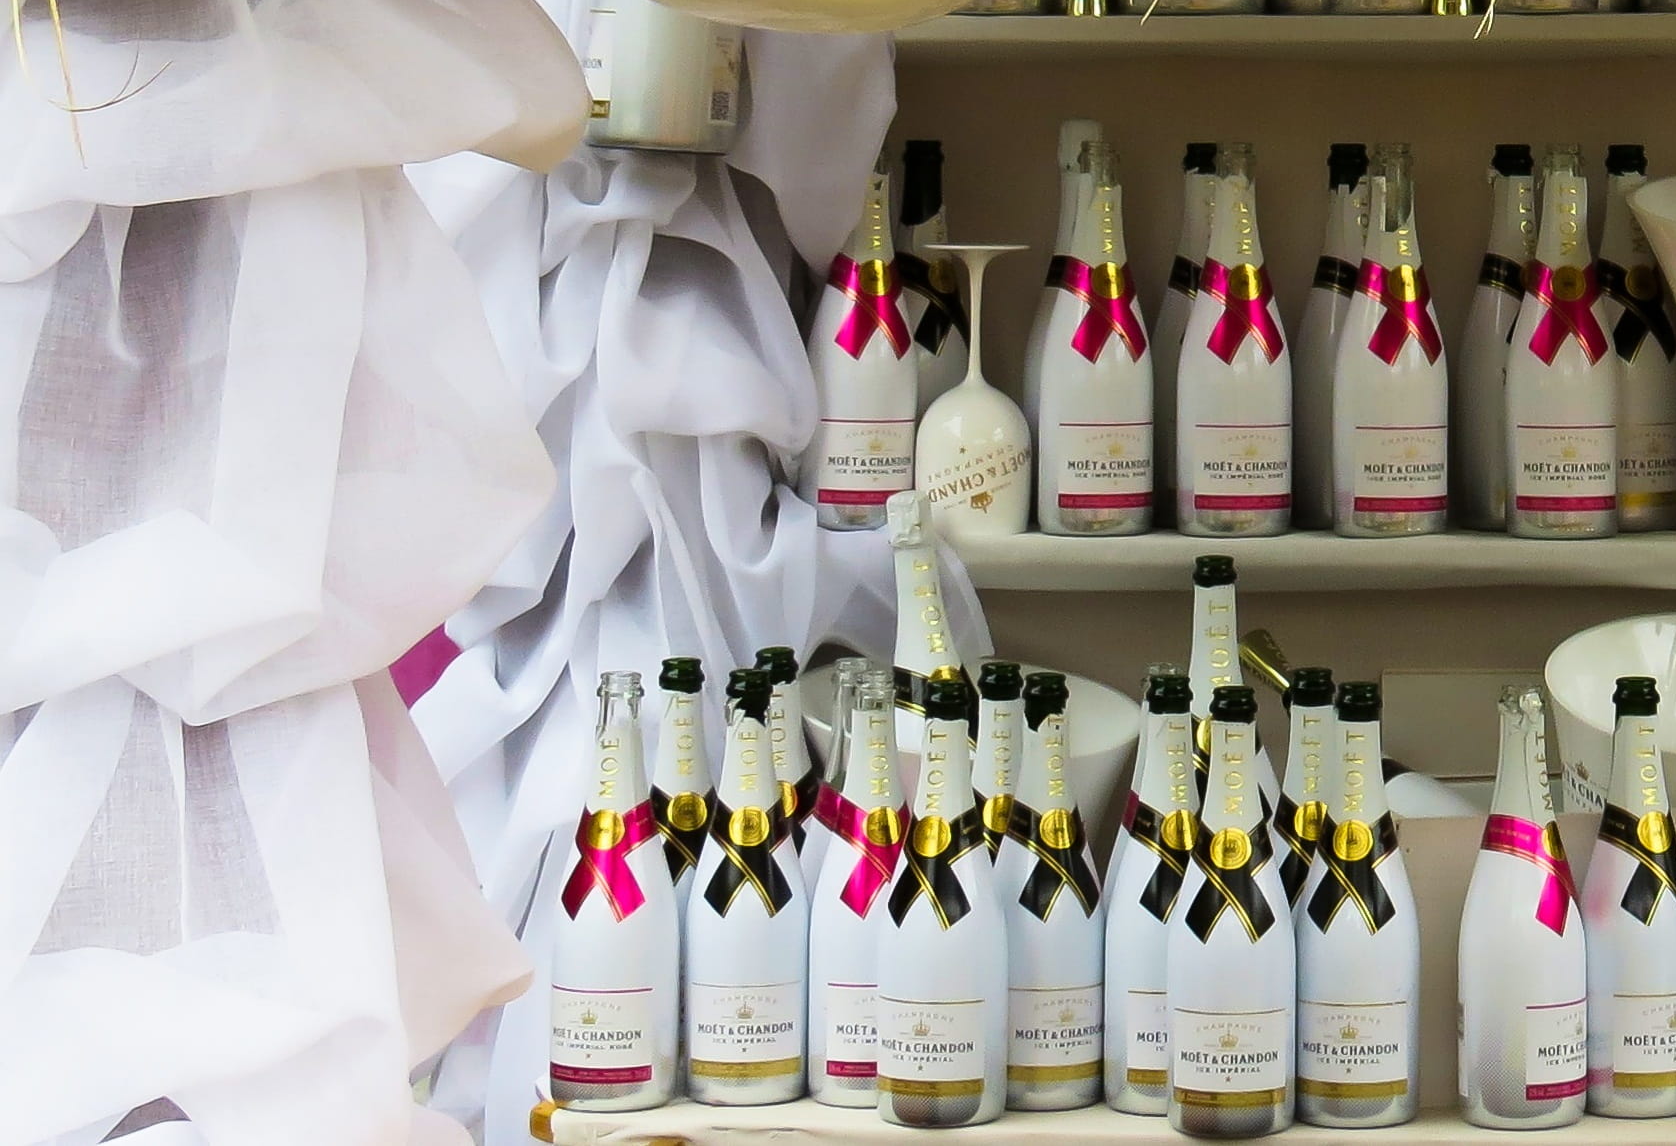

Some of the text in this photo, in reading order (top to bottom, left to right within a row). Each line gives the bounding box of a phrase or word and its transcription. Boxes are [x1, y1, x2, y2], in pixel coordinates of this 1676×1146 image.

[1236, 464, 1242, 472] &
[1244, 462, 1287, 471] CHANDON
[1554, 465, 1560, 473] &
[1563, 463, 1610, 473] CHANDON
[737, 1022, 793, 1035] CHANDON
[582, 1030, 641, 1041] CHANDON
[1660, 1037, 1666, 1045] &
[906, 1044, 911, 1052] &
[914, 1042, 973, 1053] CHANDON
[1332, 1047, 1337, 1056] &
[1341, 1044, 1398, 1056] CHANDON
[1212, 1056, 1218, 1064] &
[1221, 1051, 1277, 1065] CHANDON
